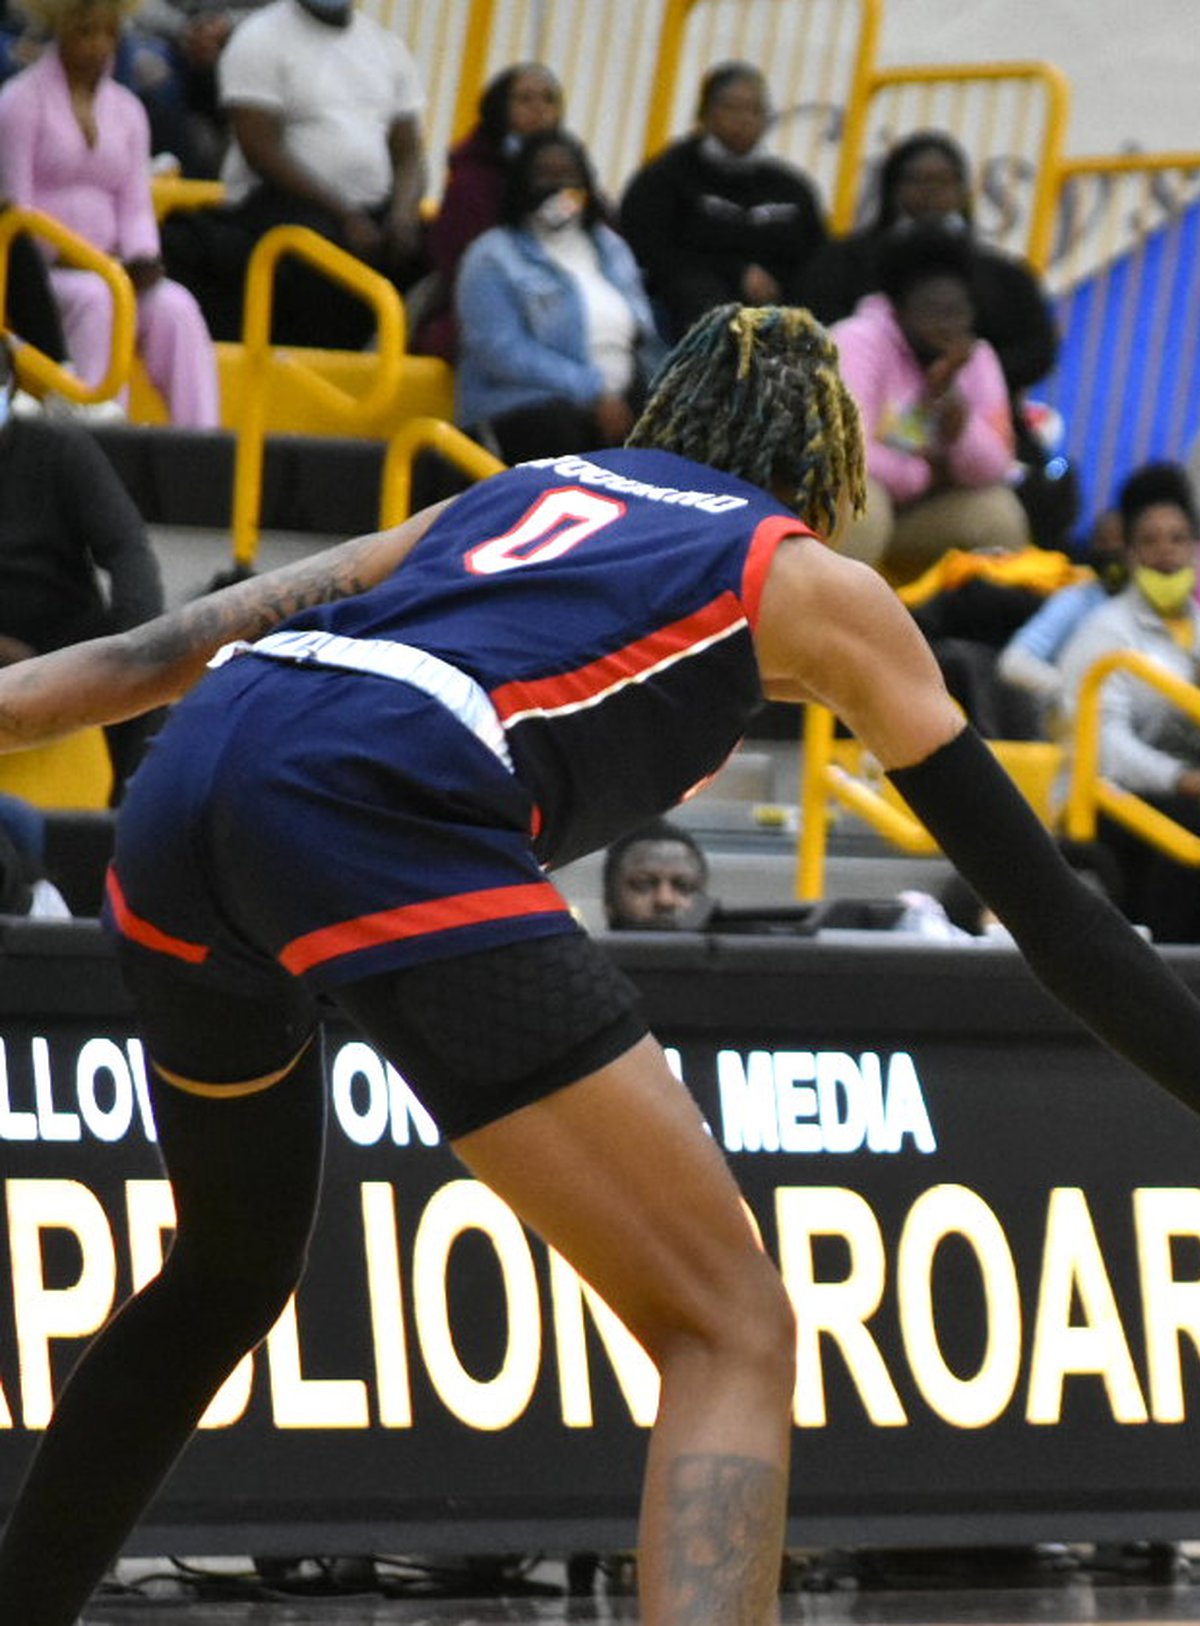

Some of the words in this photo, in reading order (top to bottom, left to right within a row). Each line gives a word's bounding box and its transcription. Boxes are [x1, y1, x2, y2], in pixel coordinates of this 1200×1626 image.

[464, 485, 627, 575] 0
[717, 1049, 937, 1154] MEDIA
[266, 1179, 763, 1431] LION
